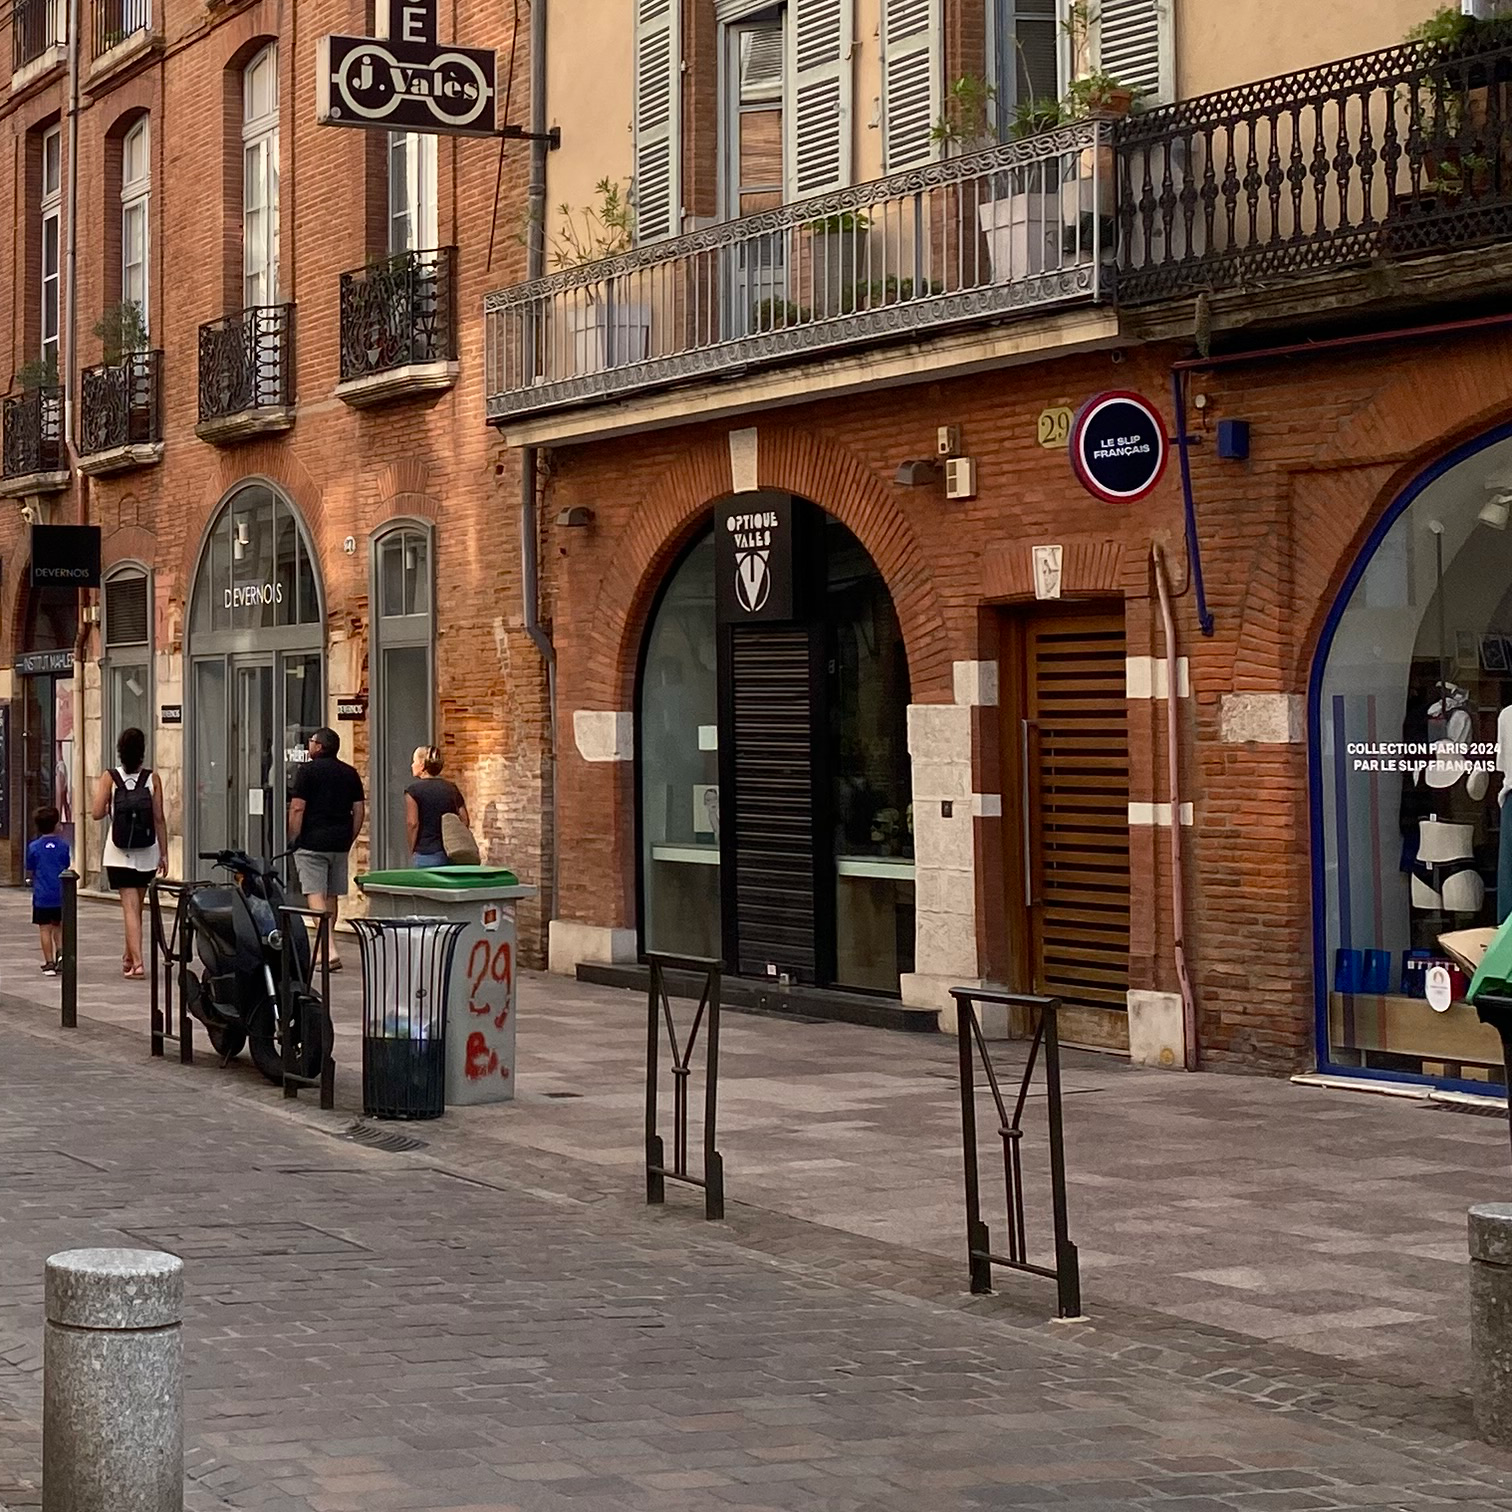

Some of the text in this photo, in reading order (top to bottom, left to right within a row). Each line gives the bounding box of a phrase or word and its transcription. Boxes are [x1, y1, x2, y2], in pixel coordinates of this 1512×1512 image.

[1041, 411, 1070, 444] 29
[1101, 435, 1141, 448] LE SLIP
[1093, 444, 1150, 459] FRANÇAIS
[727, 511, 778, 532] OPTIQUE
[734, 530, 771, 548] VALES
[35, 567, 90, 578] DEVERNOIS
[224, 582, 283, 609] DEVERNOIS
[1347, 742, 1501, 755] COLLECTION PARIS 2024
[1353, 759, 1496, 774] PAR LE SLIP FRANÇAIS
